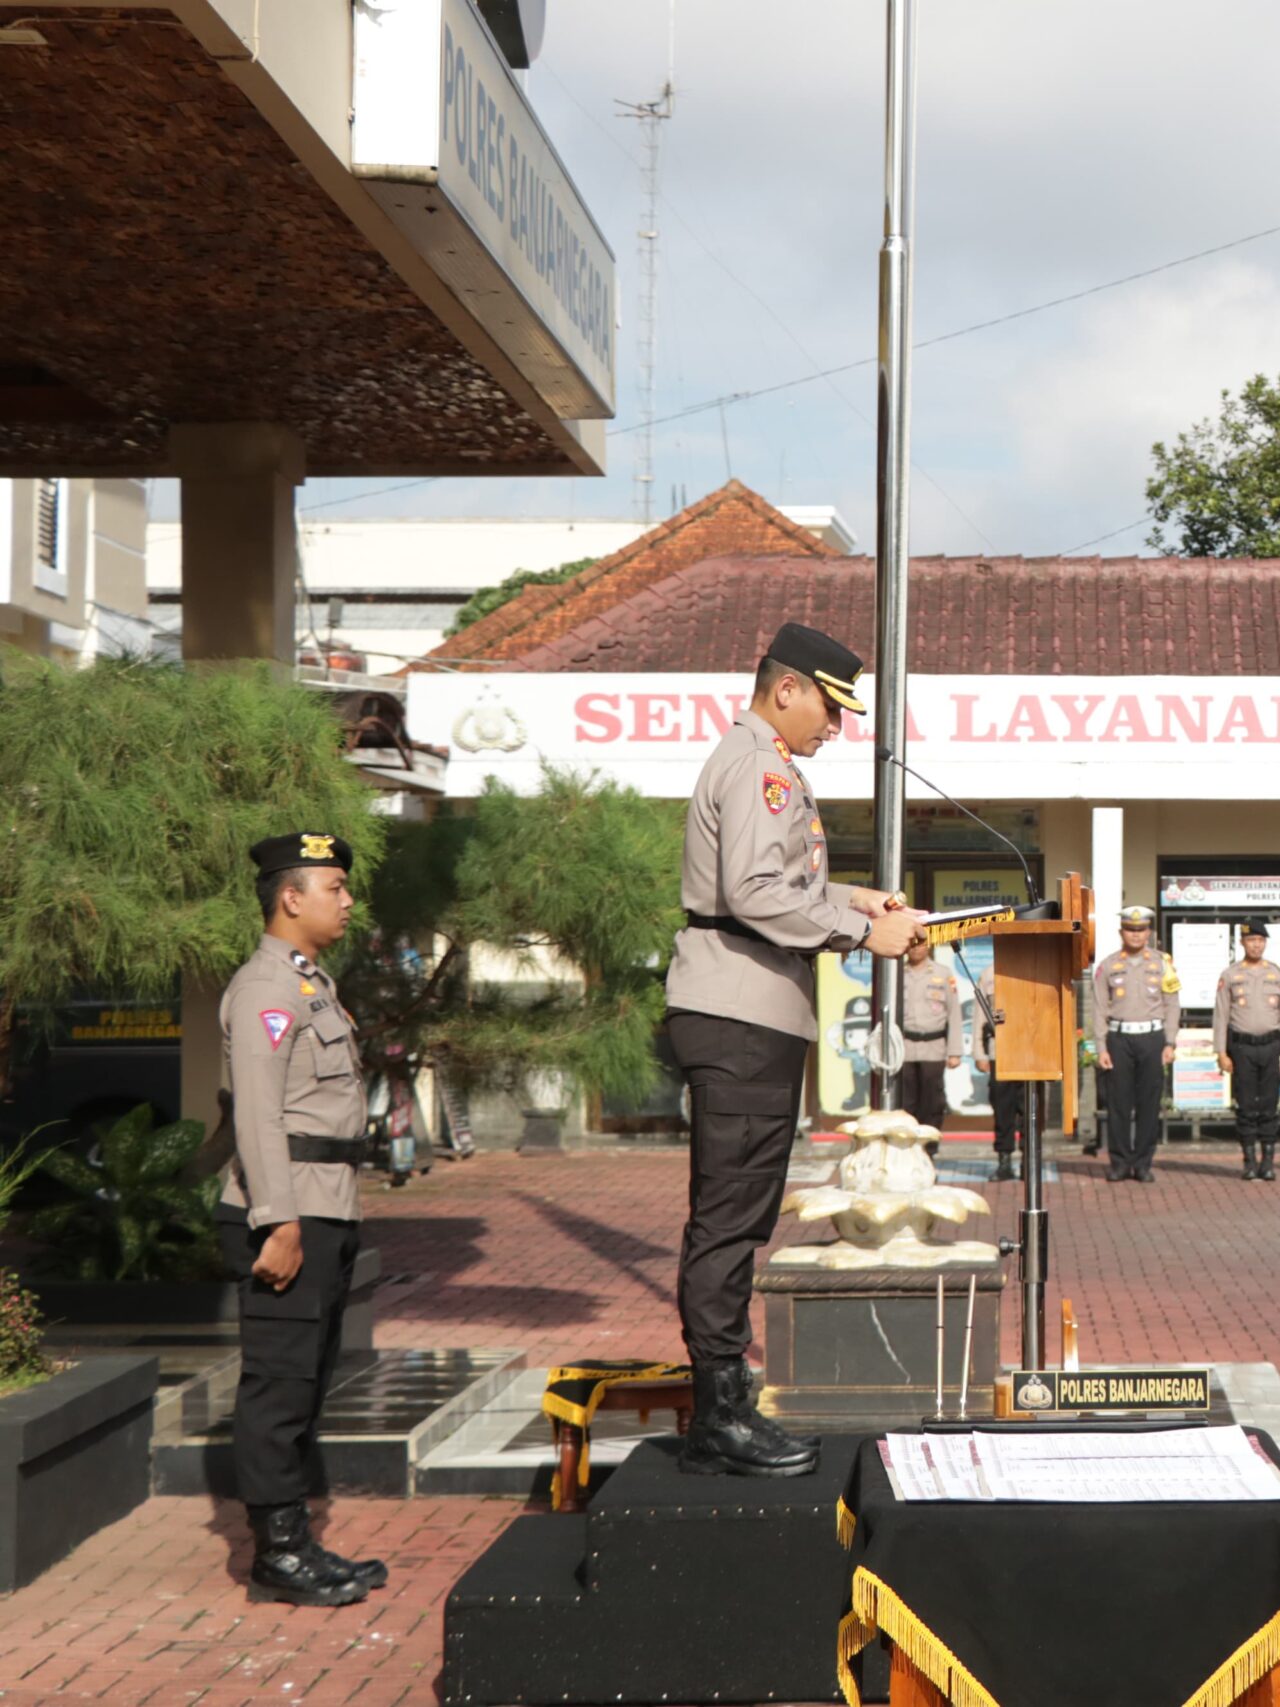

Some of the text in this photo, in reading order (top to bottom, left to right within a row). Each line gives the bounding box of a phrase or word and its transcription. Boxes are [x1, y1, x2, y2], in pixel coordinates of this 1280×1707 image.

[444, 20, 612, 374] POLRES BANJARNEGARA
[575, 693, 925, 743] SENRA
[963, 880, 999, 892] POLRES
[1060, 1378, 1205, 1403] POLRES BANJARNEGARA
